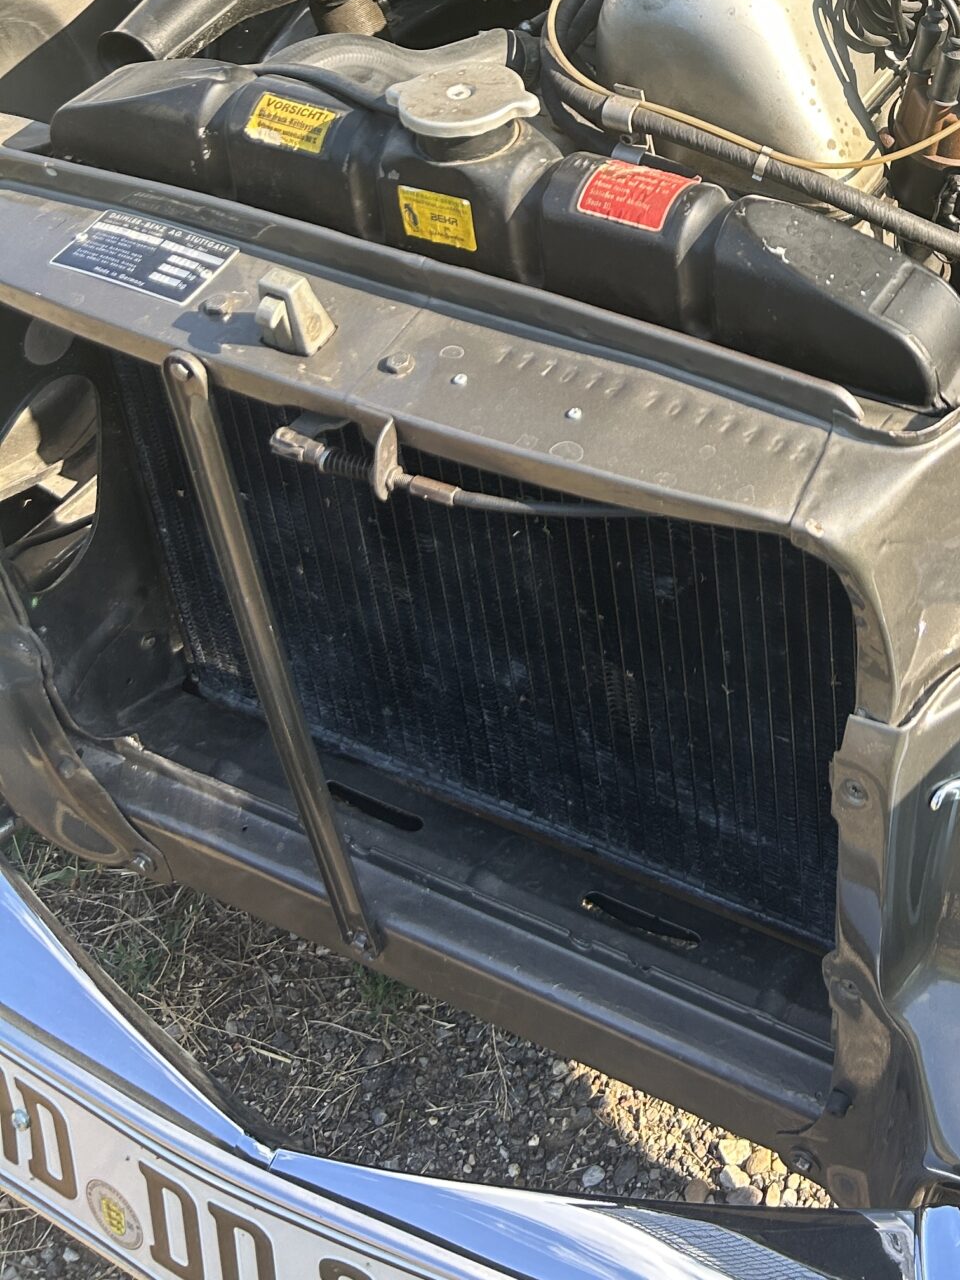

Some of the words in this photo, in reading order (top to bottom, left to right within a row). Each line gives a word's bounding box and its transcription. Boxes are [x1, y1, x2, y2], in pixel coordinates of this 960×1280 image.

[266, 98, 329, 122] VORSICHT!
[430, 212, 459, 227] BEHR
[108, 212, 167, 232] DAIMLER-BENZ
[185, 234, 230, 253] STUTTGART
